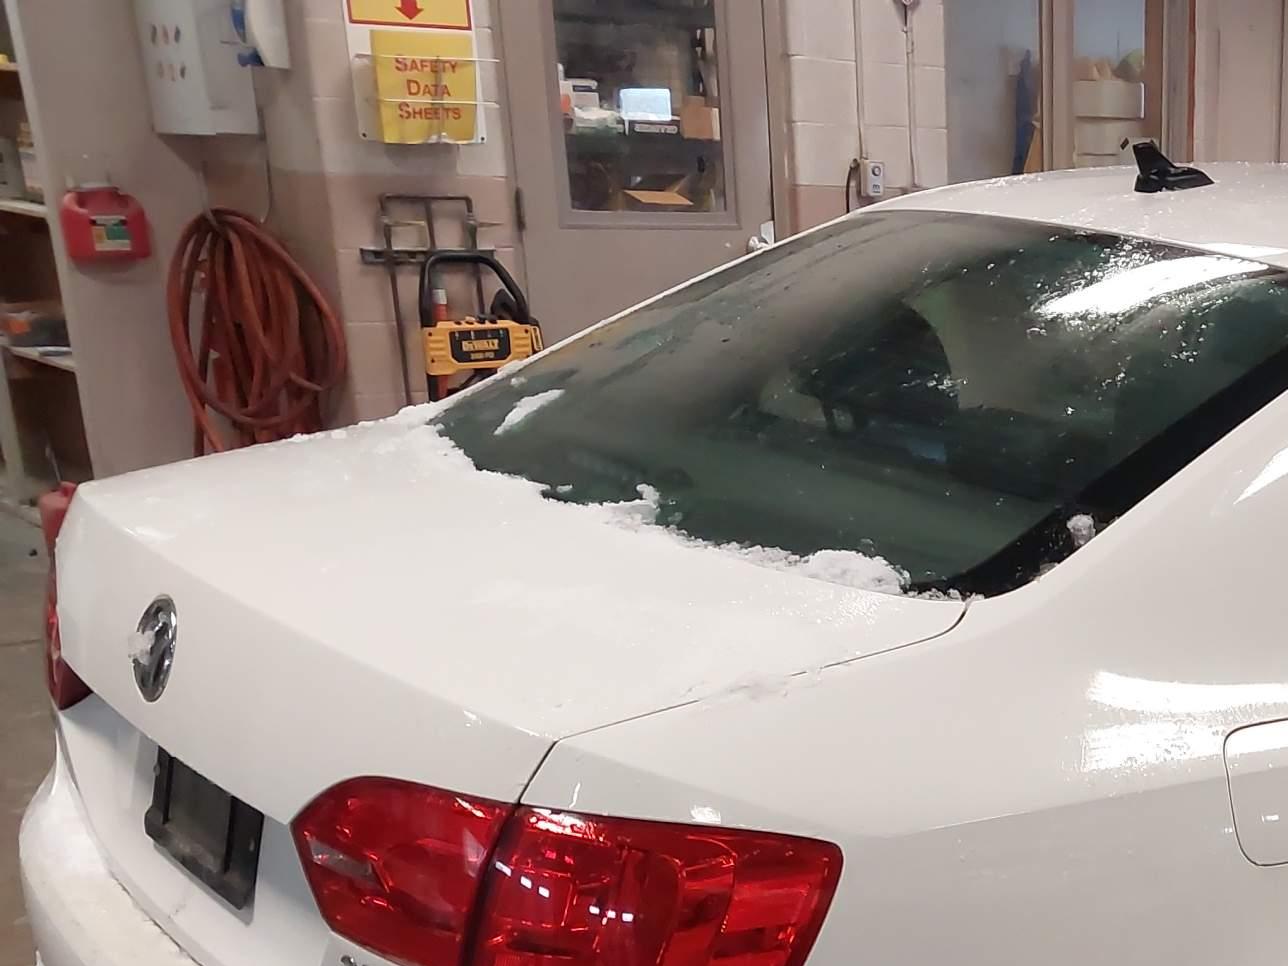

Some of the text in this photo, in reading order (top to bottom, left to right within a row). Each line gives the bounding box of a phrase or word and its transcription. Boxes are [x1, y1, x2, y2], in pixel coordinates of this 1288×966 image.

[395, 54, 459, 74] SAFETY
[406, 79, 451, 97] DATA
[398, 101, 462, 121] SHEETS
